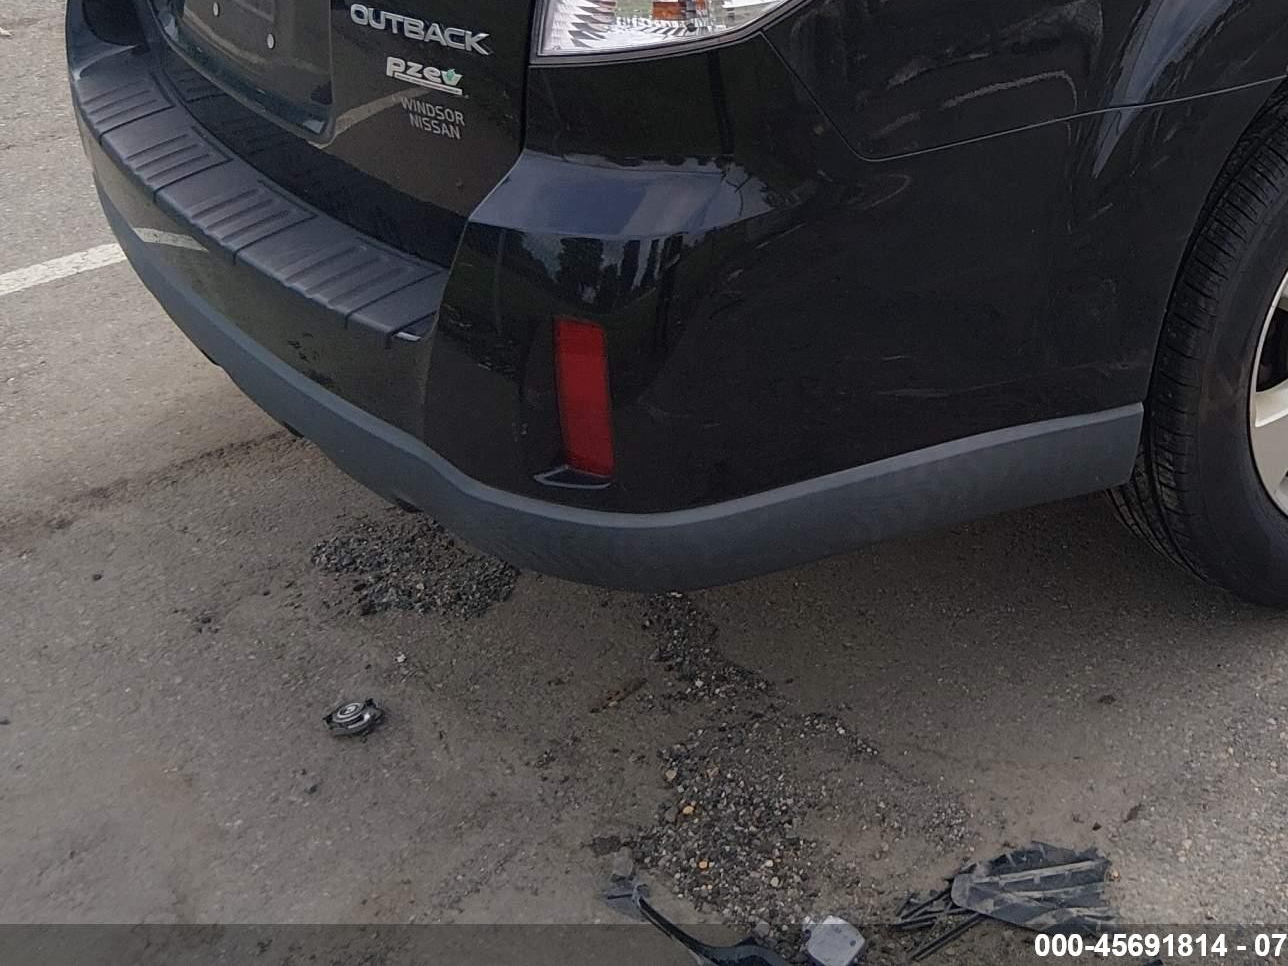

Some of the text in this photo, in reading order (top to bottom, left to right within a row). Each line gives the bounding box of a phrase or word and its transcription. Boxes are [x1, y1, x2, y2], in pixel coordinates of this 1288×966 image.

[350, 3, 491, 56] OUTBACK
[401, 96, 465, 126] WINDSOR
[409, 113, 461, 140] NISSAN
